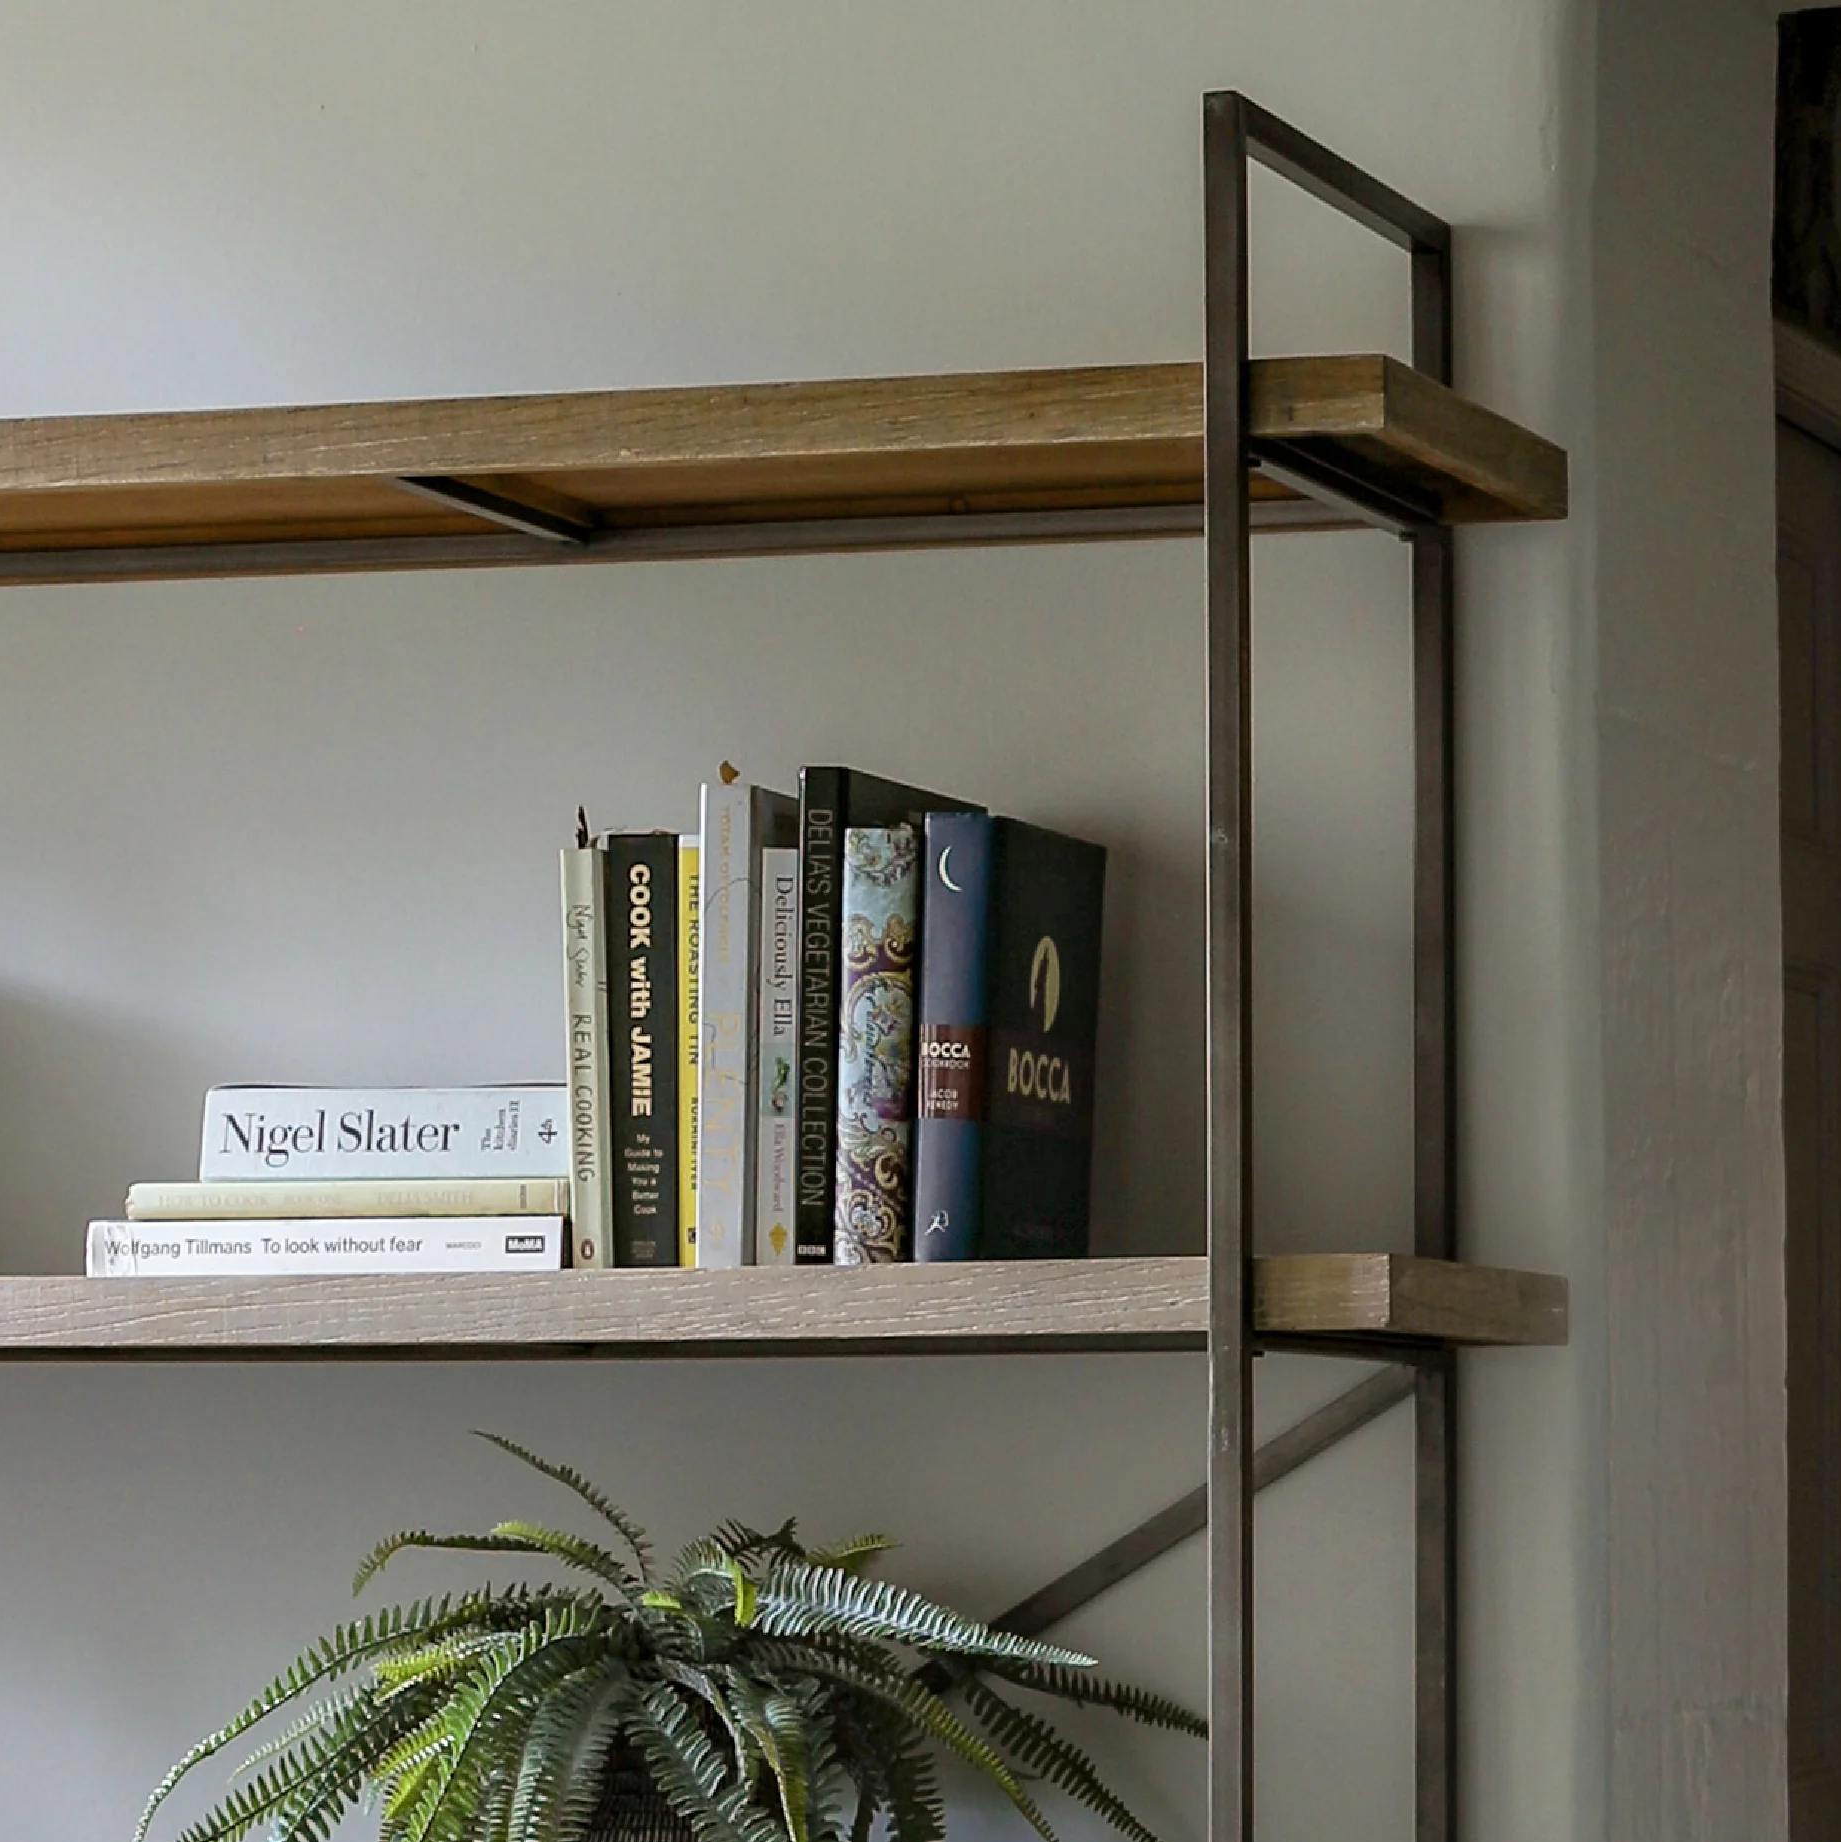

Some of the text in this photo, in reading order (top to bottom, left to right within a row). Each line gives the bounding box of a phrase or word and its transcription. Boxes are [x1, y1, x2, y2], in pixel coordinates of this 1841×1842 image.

[629, 863, 653, 1117] COOK with JAMIE
[765, 877, 795, 1037] Deliciously Ella
[801, 809, 833, 1207] DELIA'S VEGETARIAN COLLECTION
[572, 1014, 596, 1182] REAL COOKING
[704, 1013, 740, 1197] PLENTY
[920, 1042, 971, 1058] BOCCA
[1008, 1048, 1071, 1105] BOCCA
[219, 1109, 460, 1168] Nigel Slater
[105, 1236, 423, 1259] Wolfgang Tillmans To look without fear
